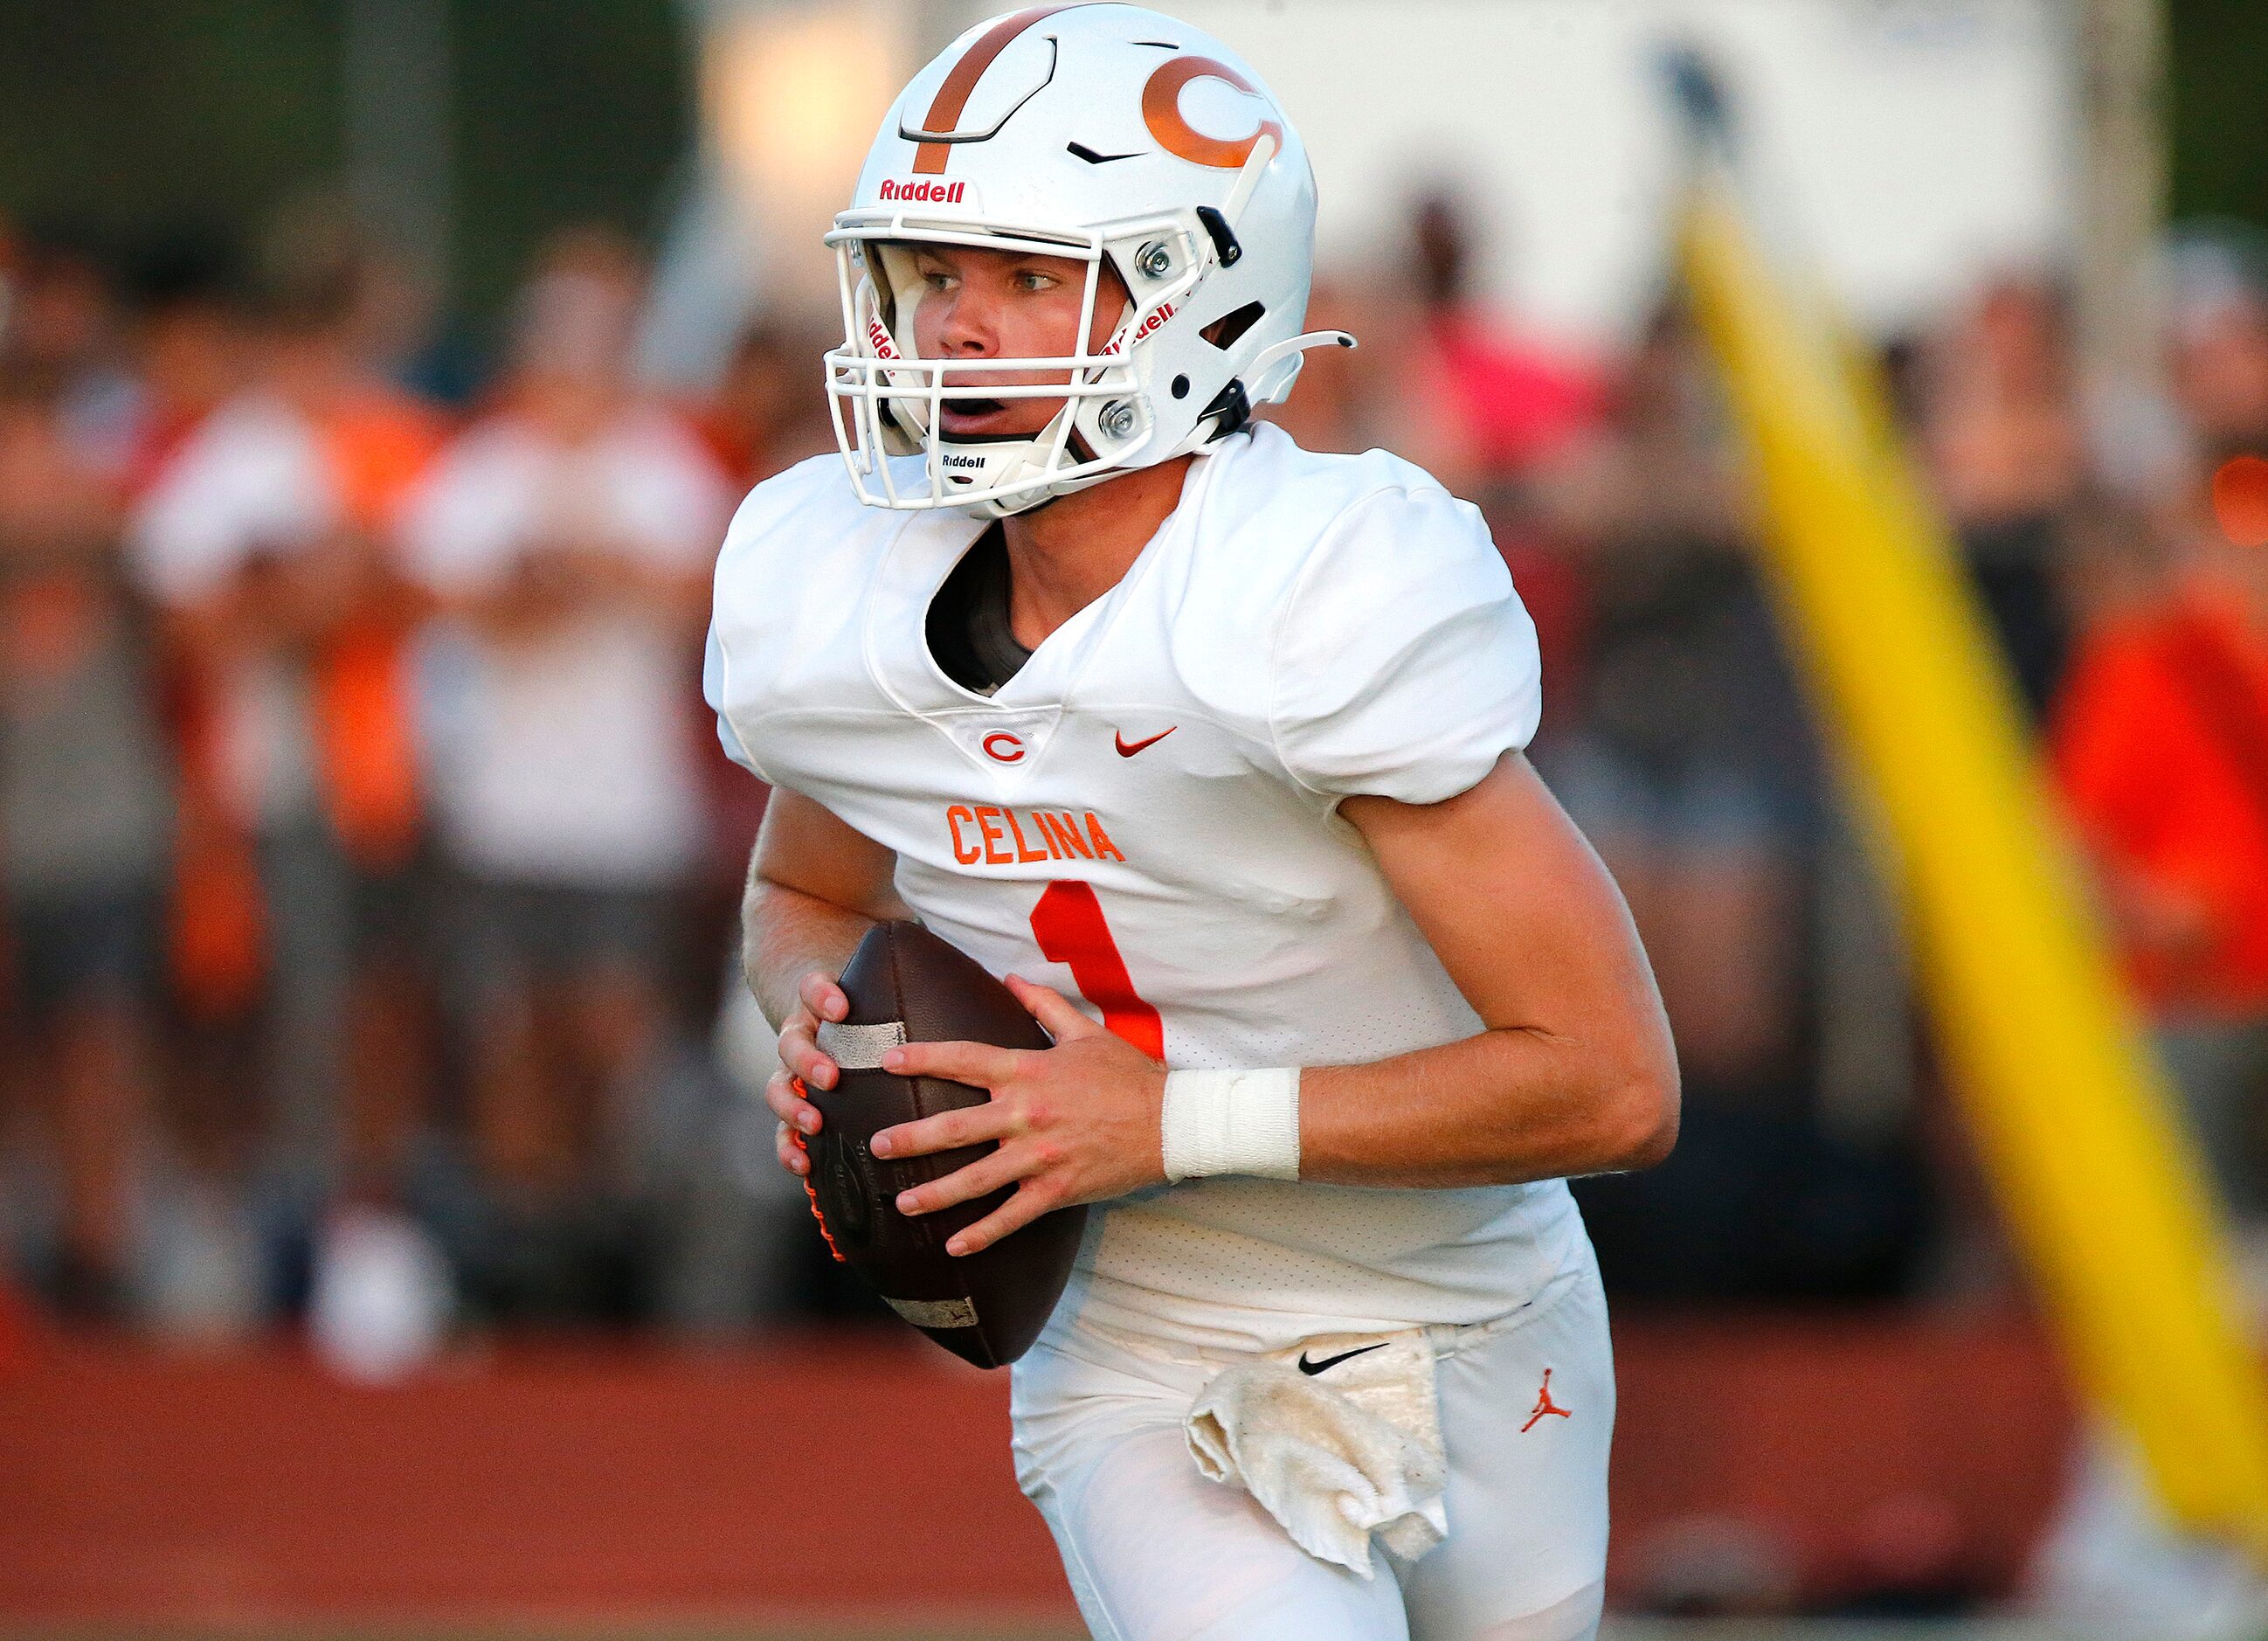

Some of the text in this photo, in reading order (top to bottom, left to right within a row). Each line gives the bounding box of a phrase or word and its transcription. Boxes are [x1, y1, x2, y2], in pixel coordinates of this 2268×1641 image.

[1141, 55, 1283, 168] C
[879, 178, 965, 204] Riddell
[942, 454, 986, 468] Riddell
[982, 733, 1026, 762] C
[946, 805, 1126, 865] CELINA
[1030, 880, 1165, 1063] 1
